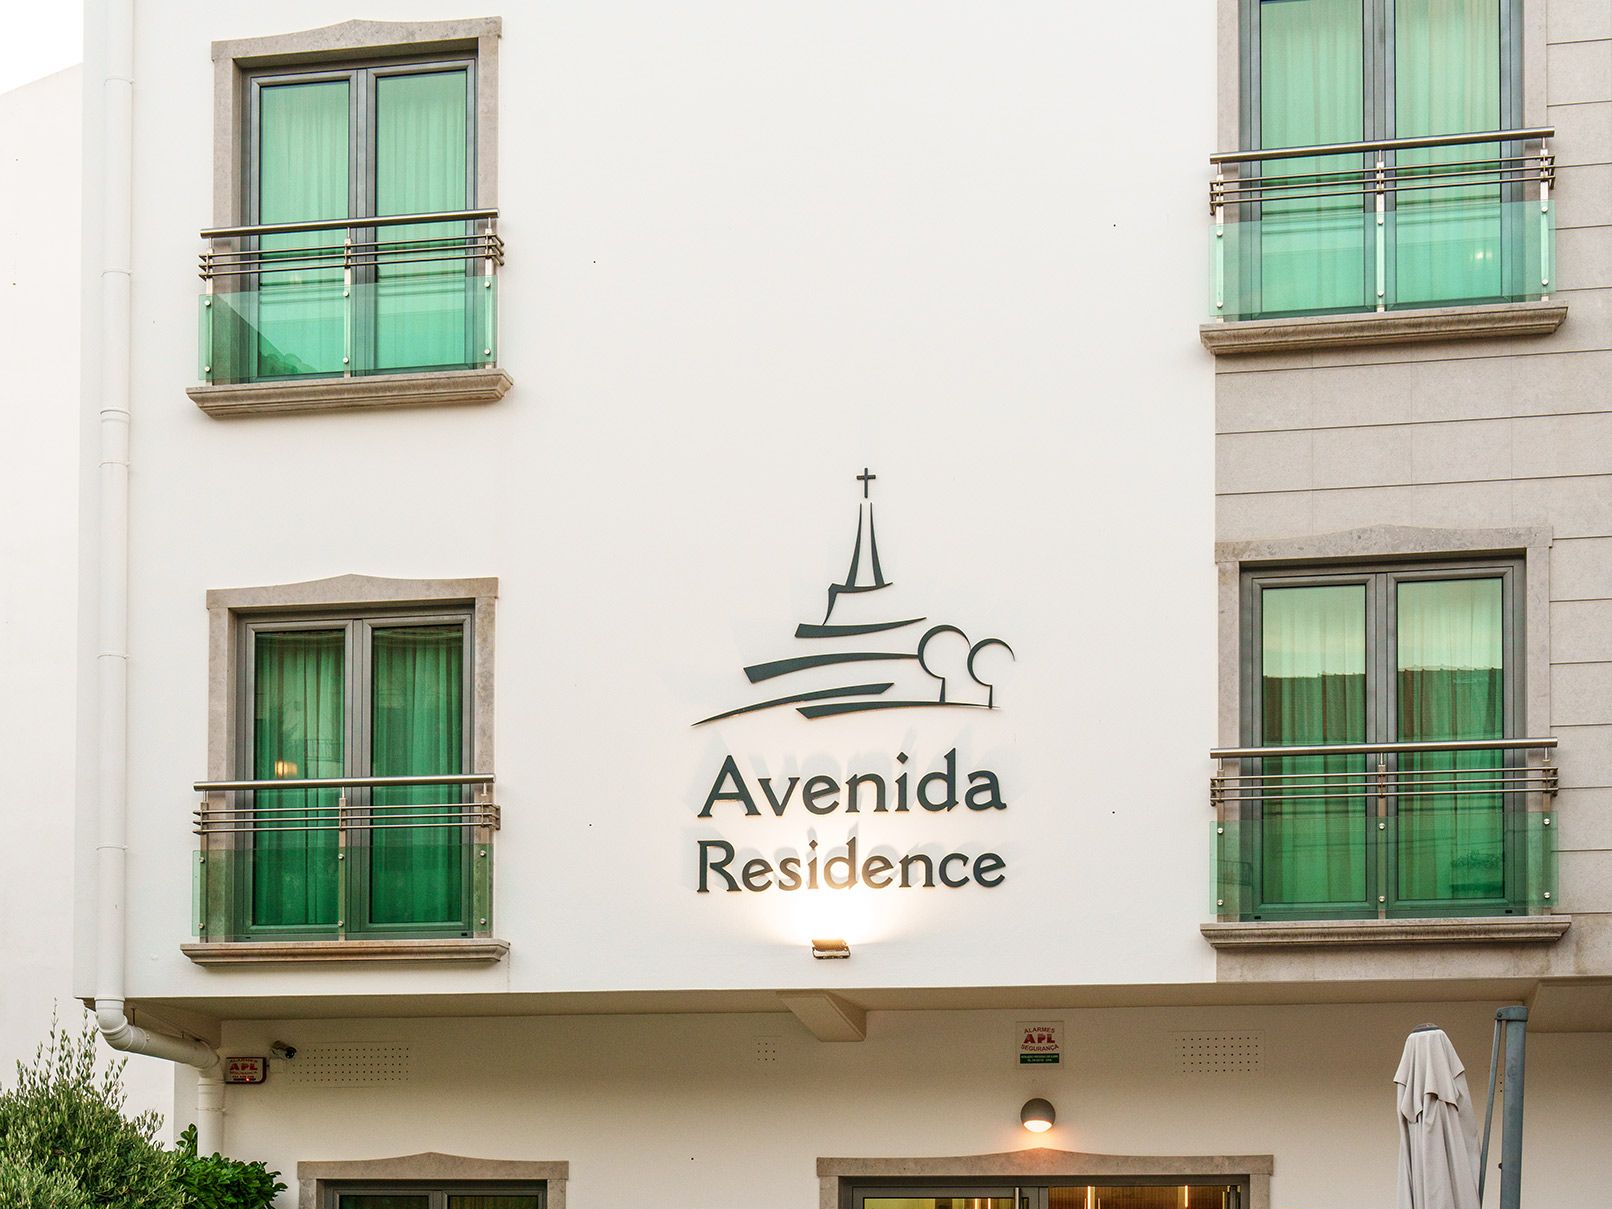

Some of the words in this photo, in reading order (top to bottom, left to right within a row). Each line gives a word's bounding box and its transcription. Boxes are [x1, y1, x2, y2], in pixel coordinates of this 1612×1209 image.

[697, 747, 1007, 818] Avenida
[697, 836, 1007, 893] Residence
[1024, 1026, 1055, 1034] ALARMES
[1023, 1033, 1056, 1044] APL
[229, 1063, 257, 1071] APL
